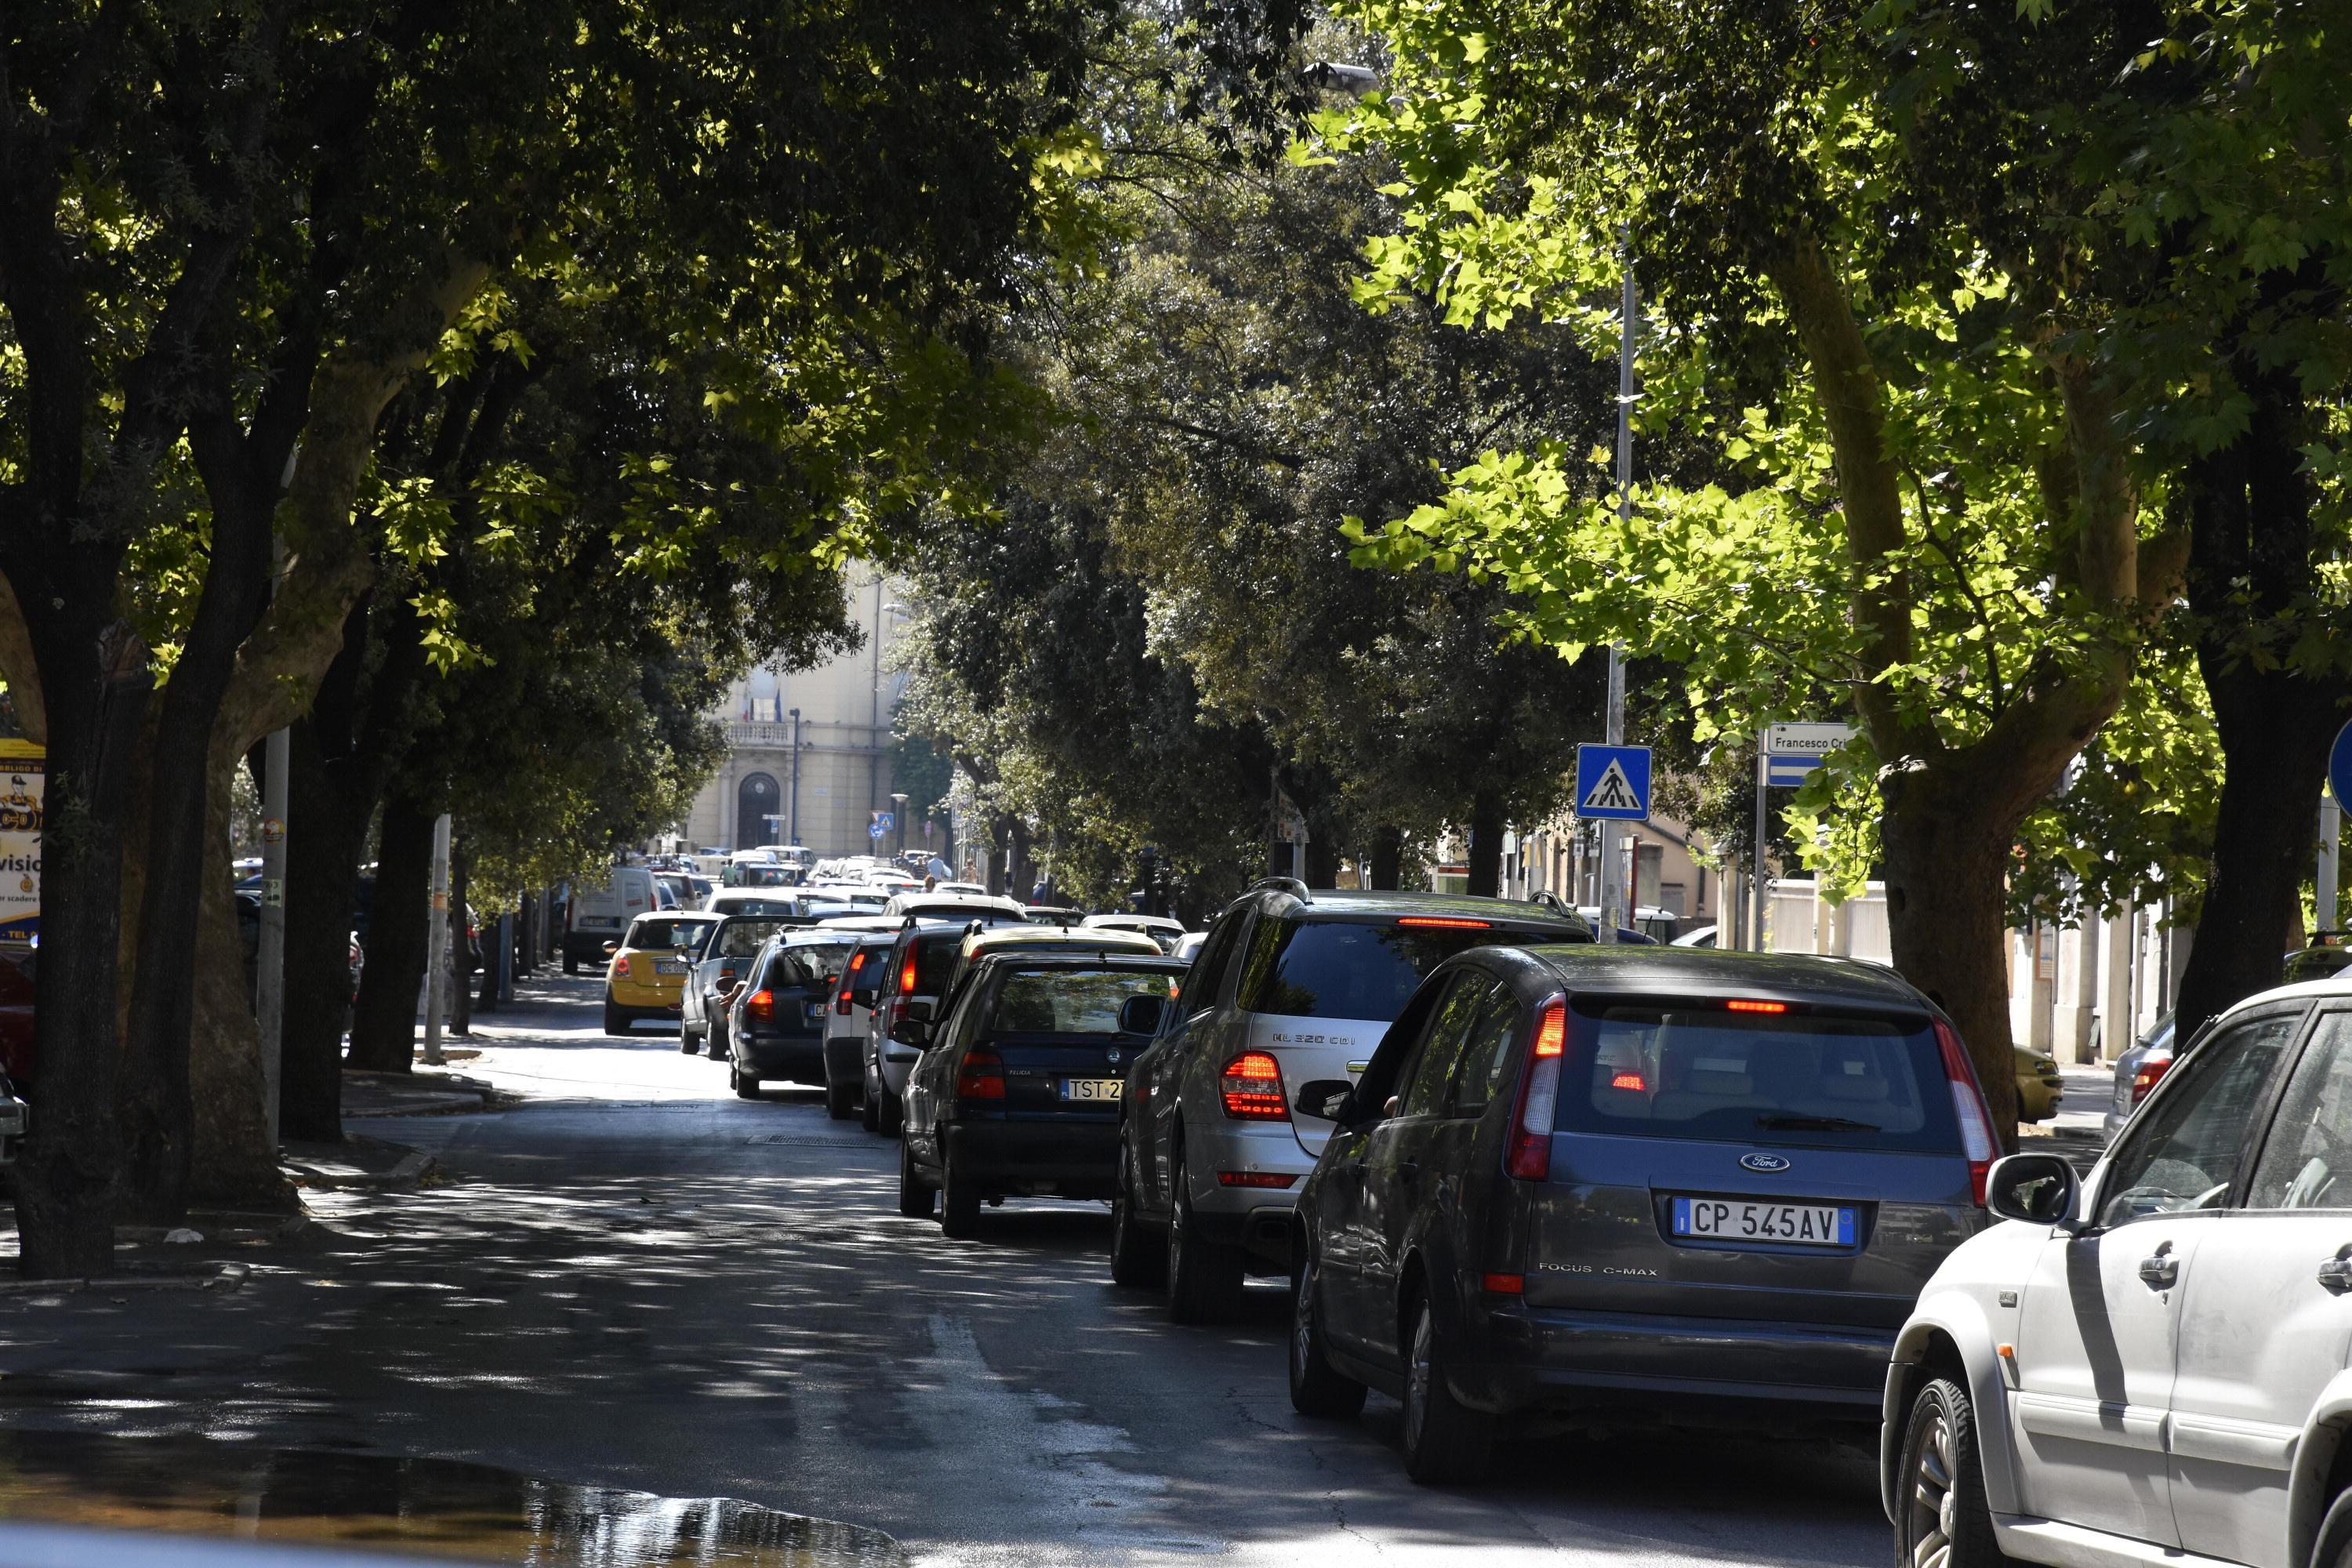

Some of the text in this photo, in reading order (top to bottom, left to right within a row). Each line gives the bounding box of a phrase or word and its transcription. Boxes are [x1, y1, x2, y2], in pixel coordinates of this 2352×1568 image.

[1776, 737, 1828, 749] Francesco
[1272, 1033, 1355, 1045] ML 320 CDI
[1070, 1080, 1104, 1098] TST
[1751, 1156, 1778, 1168] Ford
[1694, 1203, 1834, 1240] CP 545AV
[1539, 1262, 1658, 1277] FOCUS C-MAX
